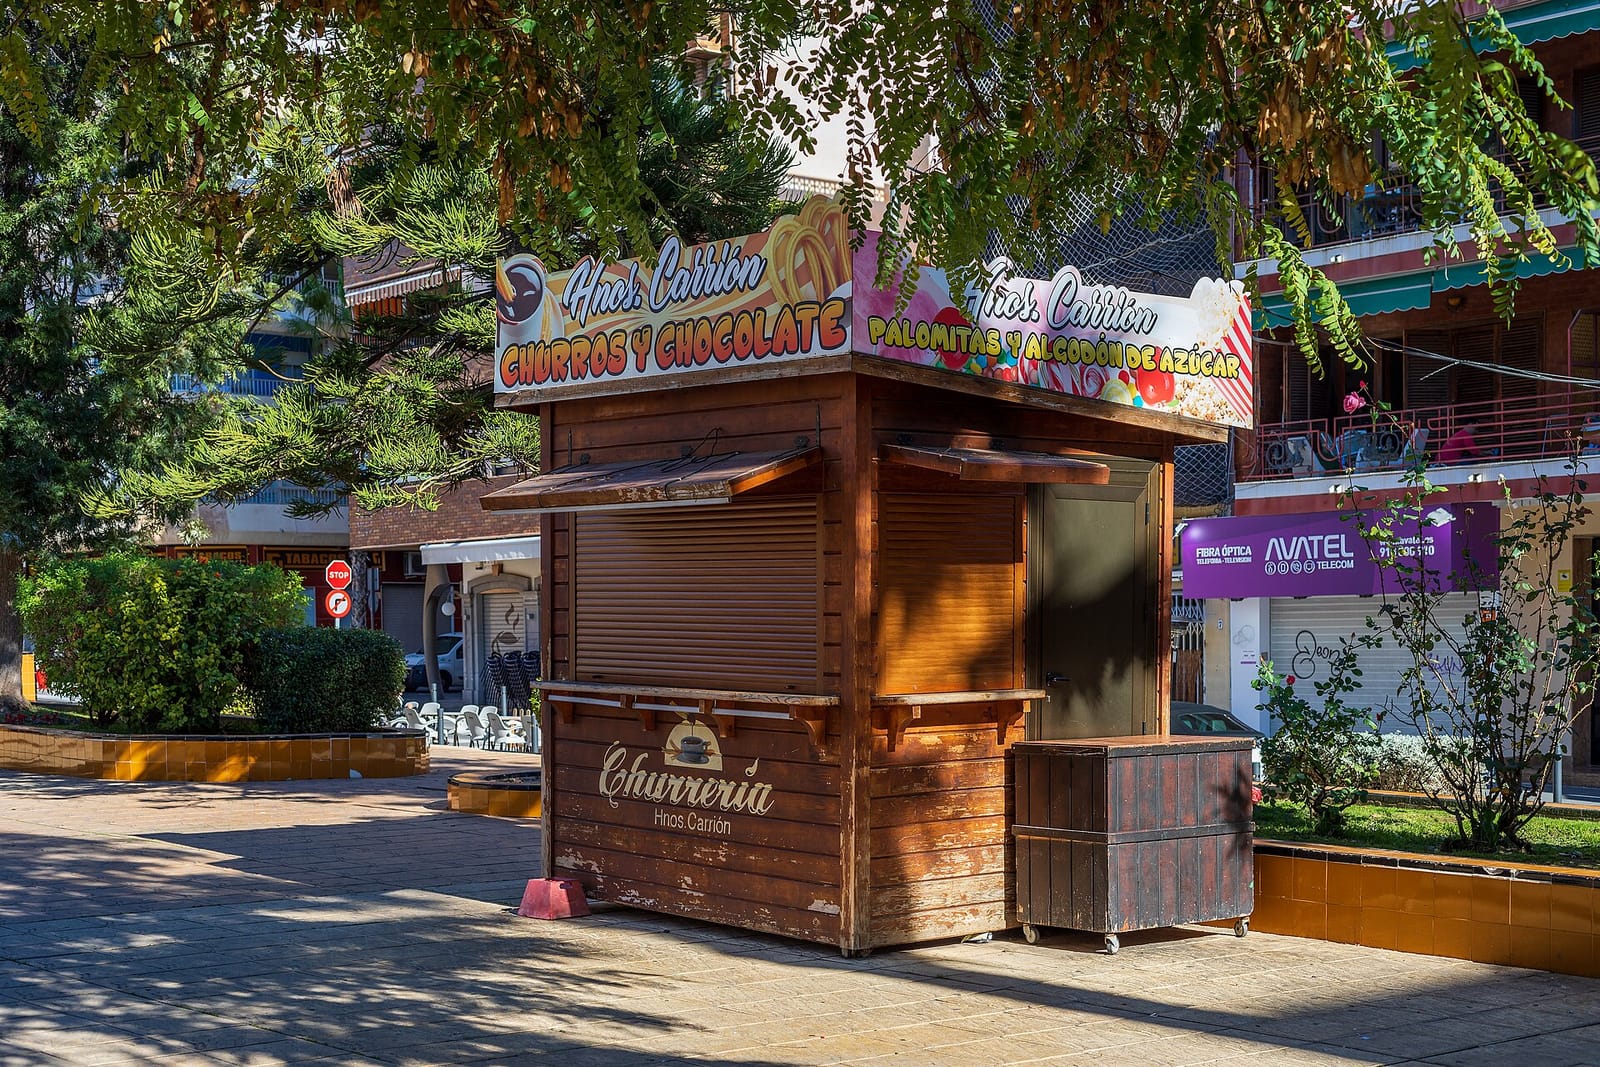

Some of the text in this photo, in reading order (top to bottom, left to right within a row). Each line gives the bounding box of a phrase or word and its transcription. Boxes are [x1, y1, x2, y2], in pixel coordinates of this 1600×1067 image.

[562, 235, 767, 329] Hnos. Carrión
[1047, 271, 1158, 334] Carrión
[500, 298, 847, 387] CHURROS Y CHOCOLATE
[867, 315, 1241, 378] PALOMITAS Y ALGODÓN DE AZÚCAR
[329, 571, 349, 579] STOP
[1196, 544, 1252, 558] FIBRA ÓPTICA
[1264, 533, 1354, 561] AVATEL
[1316, 559, 1354, 570] TELECOM
[599, 740, 775, 816] Churrería
